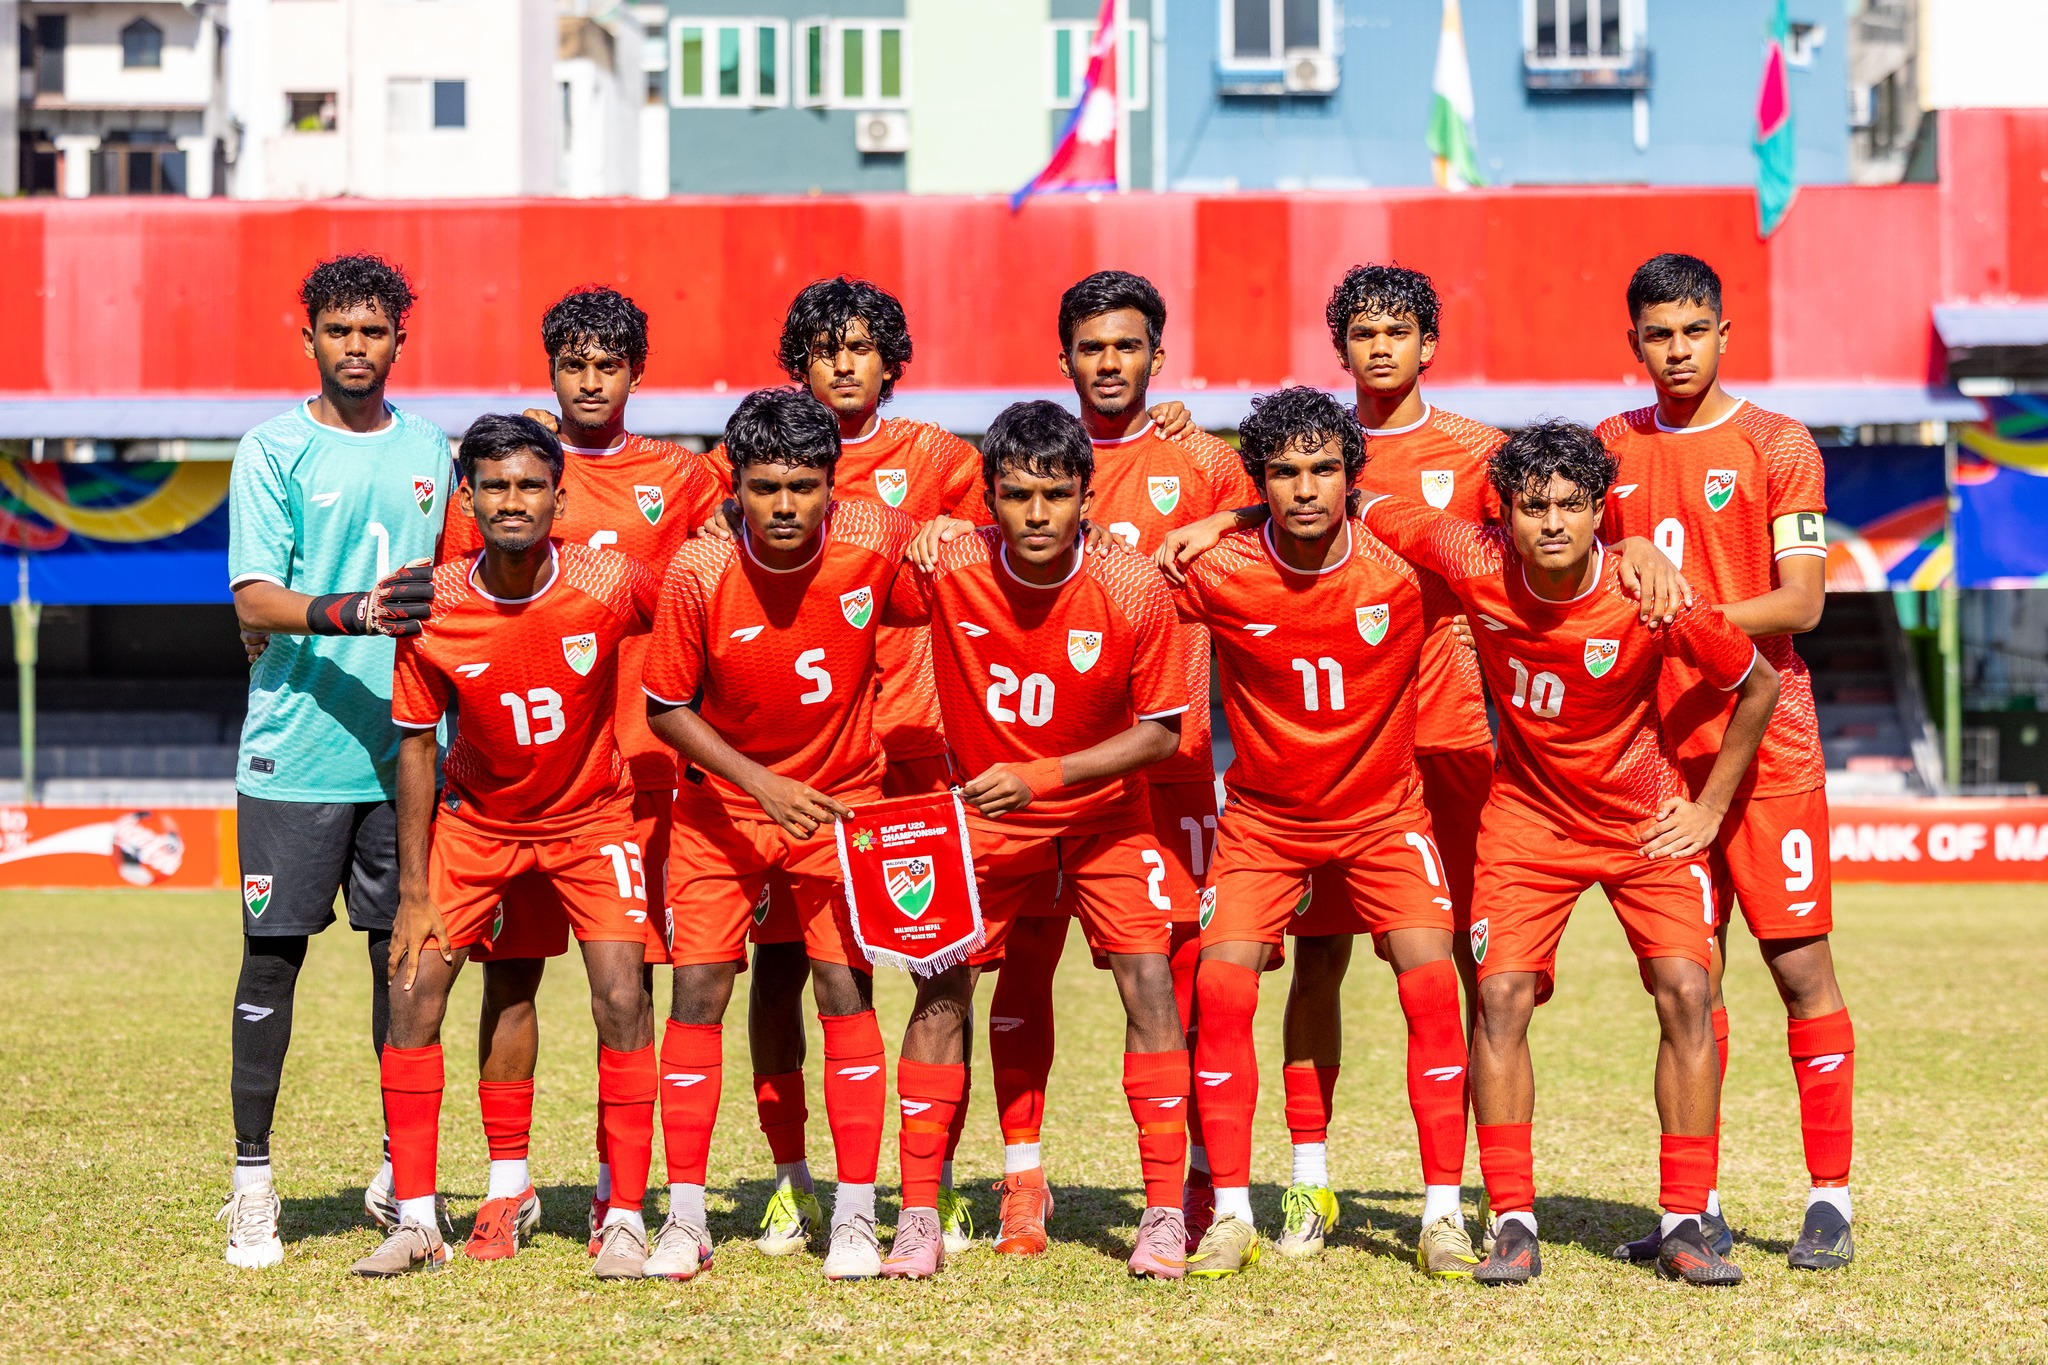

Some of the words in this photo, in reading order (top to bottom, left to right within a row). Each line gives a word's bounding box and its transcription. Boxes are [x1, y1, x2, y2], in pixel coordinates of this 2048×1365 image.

[369, 522, 390, 583] 1
[1797, 513, 1818, 541] C
[794, 647, 833, 705] 5
[986, 663, 1056, 727] 20
[1291, 656, 1345, 711] 11
[1507, 656, 1566, 718] 10
[500, 687, 566, 746] 13
[880, 824, 906, 834] SAFF
[907, 821, 926, 831] U20
[881, 826, 947, 842] CHAMPIONSHIP
[1829, 823, 1922, 862] ANK
[1927, 823, 1988, 862] OF
[599, 841, 647, 901] 13
[1140, 849, 1172, 911] 2
[1780, 828, 1814, 892] 9
[894, 926, 918, 934] MALDIVES
[924, 923, 941, 931] NEPAL
